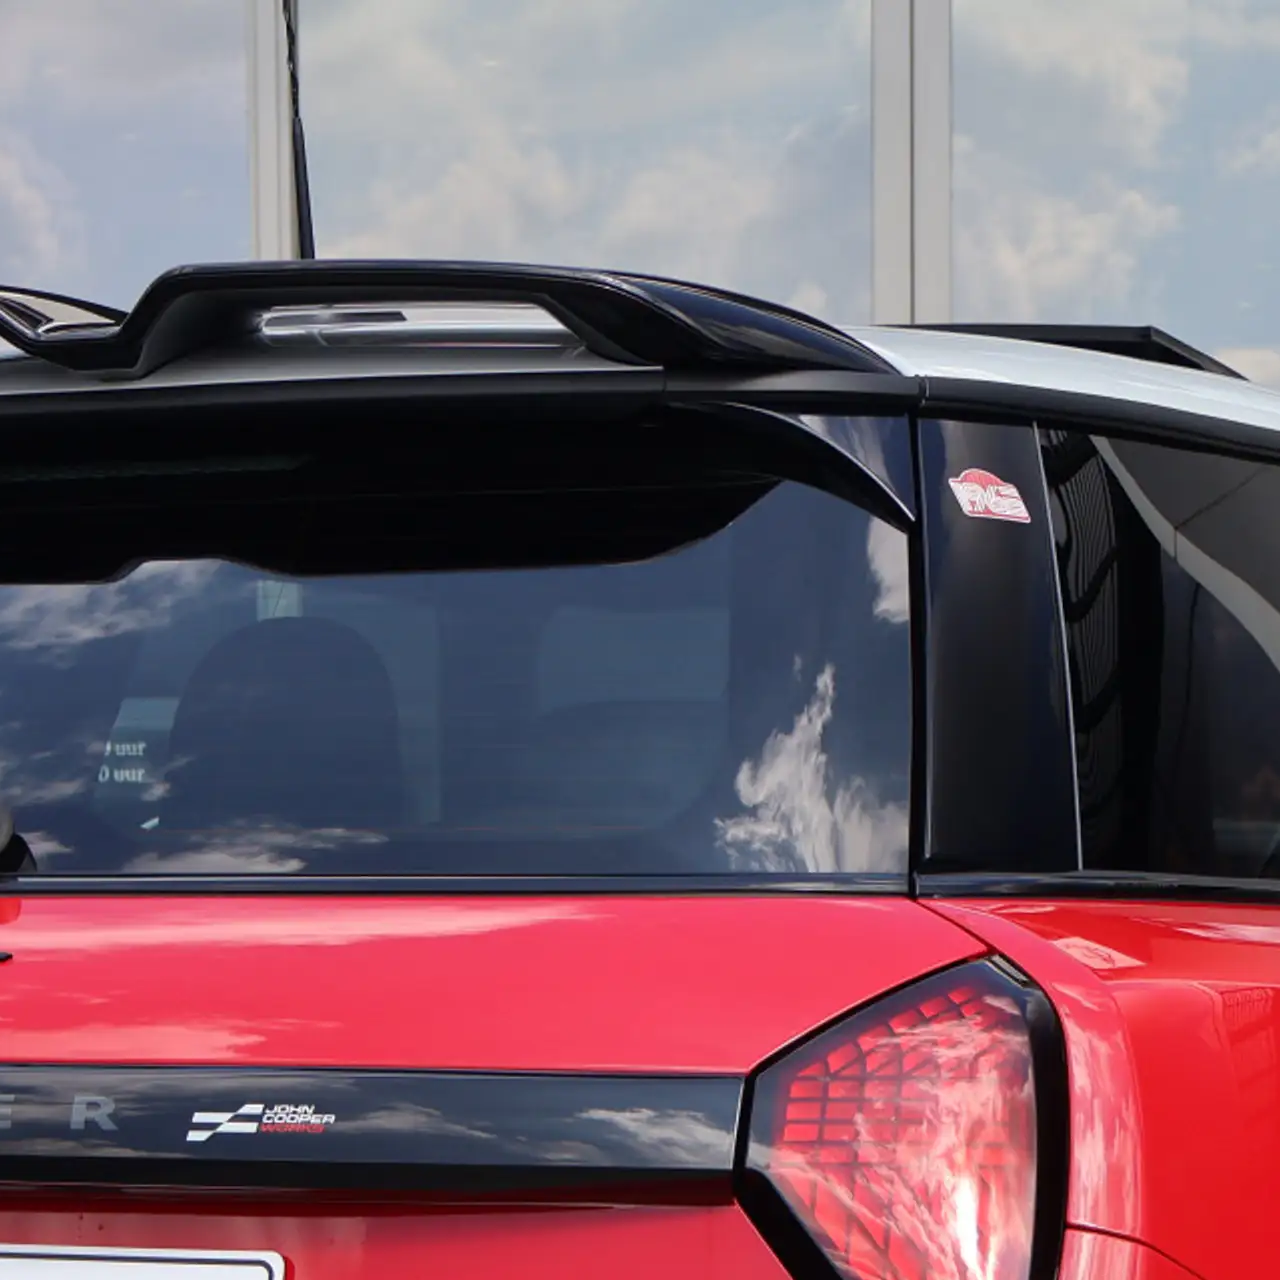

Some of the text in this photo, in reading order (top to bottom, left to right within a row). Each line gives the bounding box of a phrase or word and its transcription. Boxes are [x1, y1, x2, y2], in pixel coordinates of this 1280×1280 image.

[265, 1104, 315, 1114] JOHN
[262, 1114, 336, 1124] COOPER
[259, 1124, 325, 1133] WORKS
